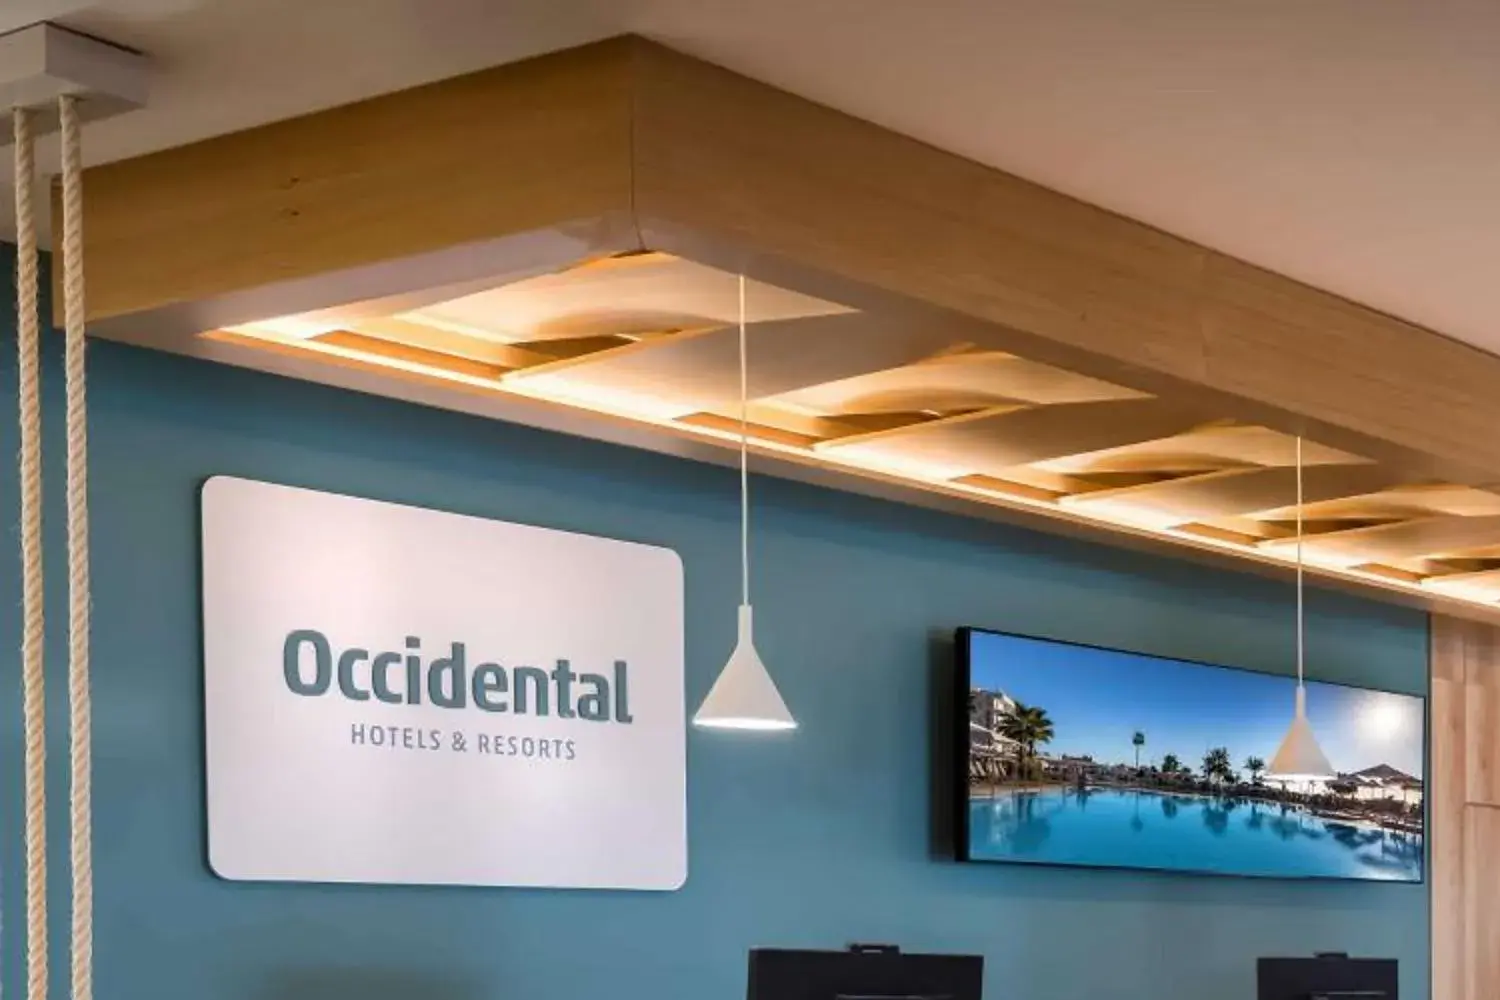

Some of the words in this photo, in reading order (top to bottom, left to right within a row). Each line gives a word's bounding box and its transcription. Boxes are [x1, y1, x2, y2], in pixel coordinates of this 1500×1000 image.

[283, 629, 633, 724] Occidental
[350, 723, 441, 751] HOTELS
[451, 731, 467, 752] &
[477, 733, 576, 760] RESORTS
